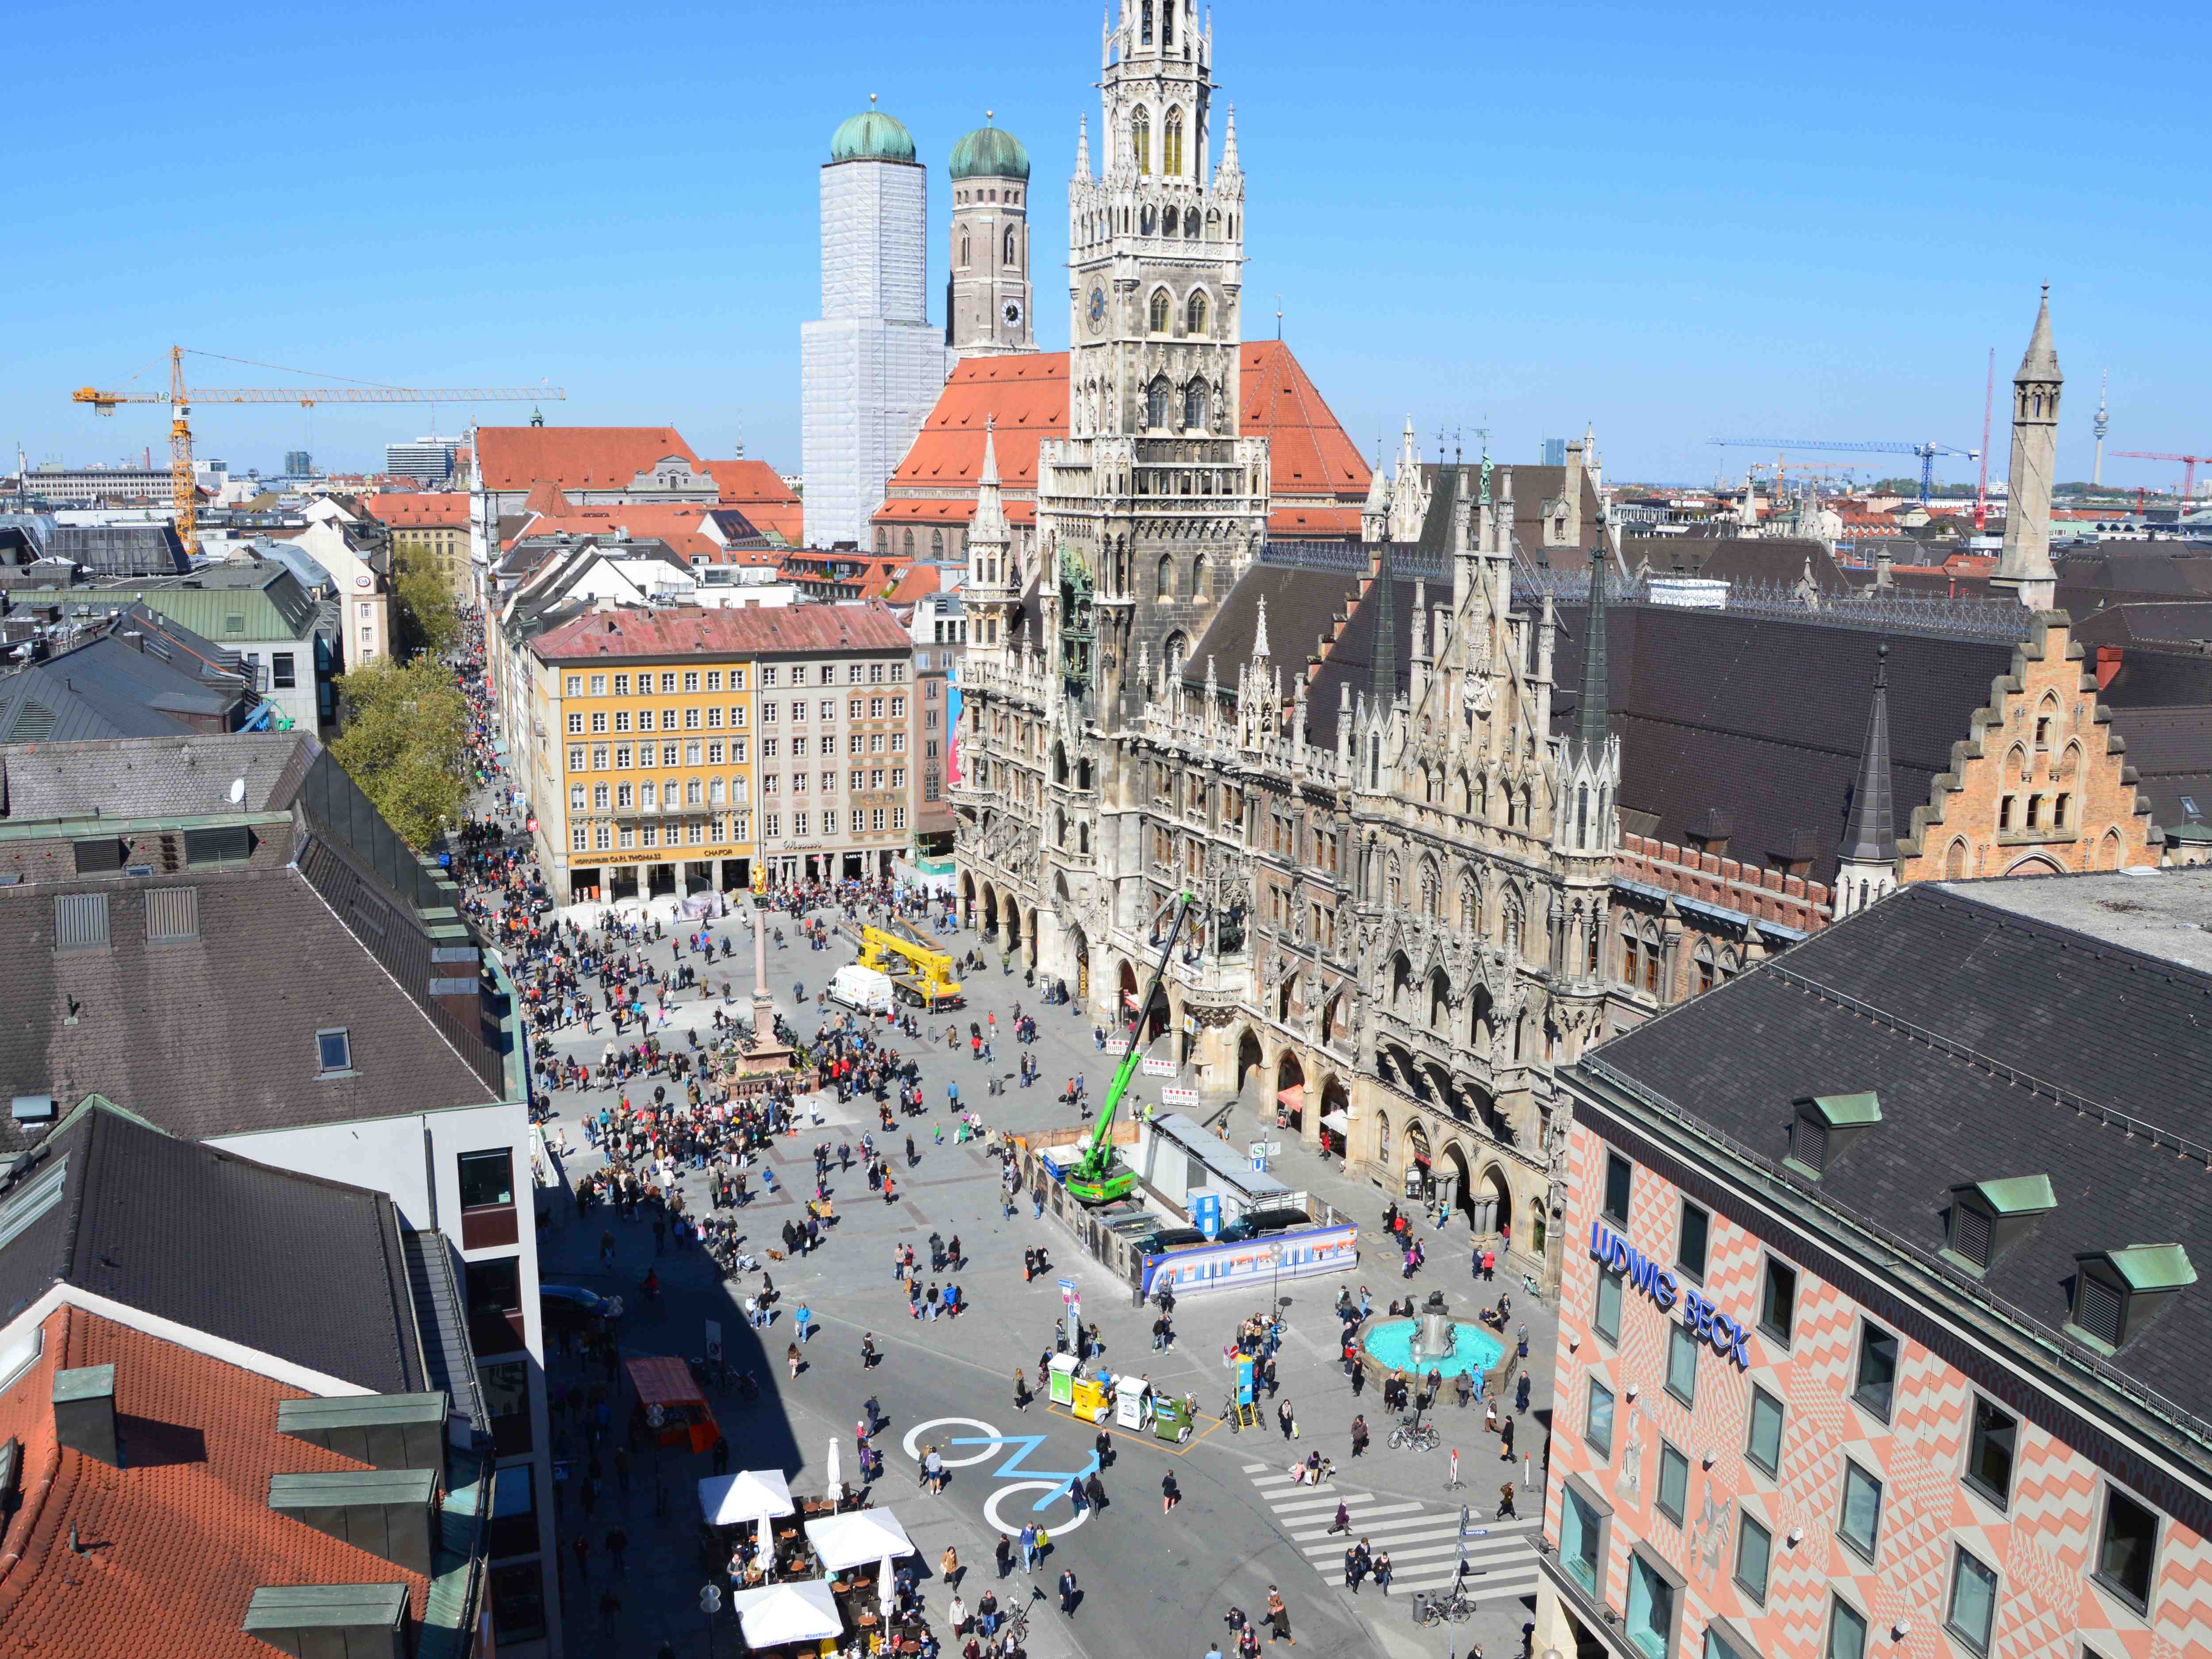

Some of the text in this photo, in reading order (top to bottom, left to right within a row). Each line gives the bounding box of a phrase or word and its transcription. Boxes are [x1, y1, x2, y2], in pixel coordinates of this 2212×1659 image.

[1254, 1146, 1264, 1156] S
[1252, 1159, 1263, 1172] U
[1590, 1221, 1751, 1367] LUDWIG BECK
